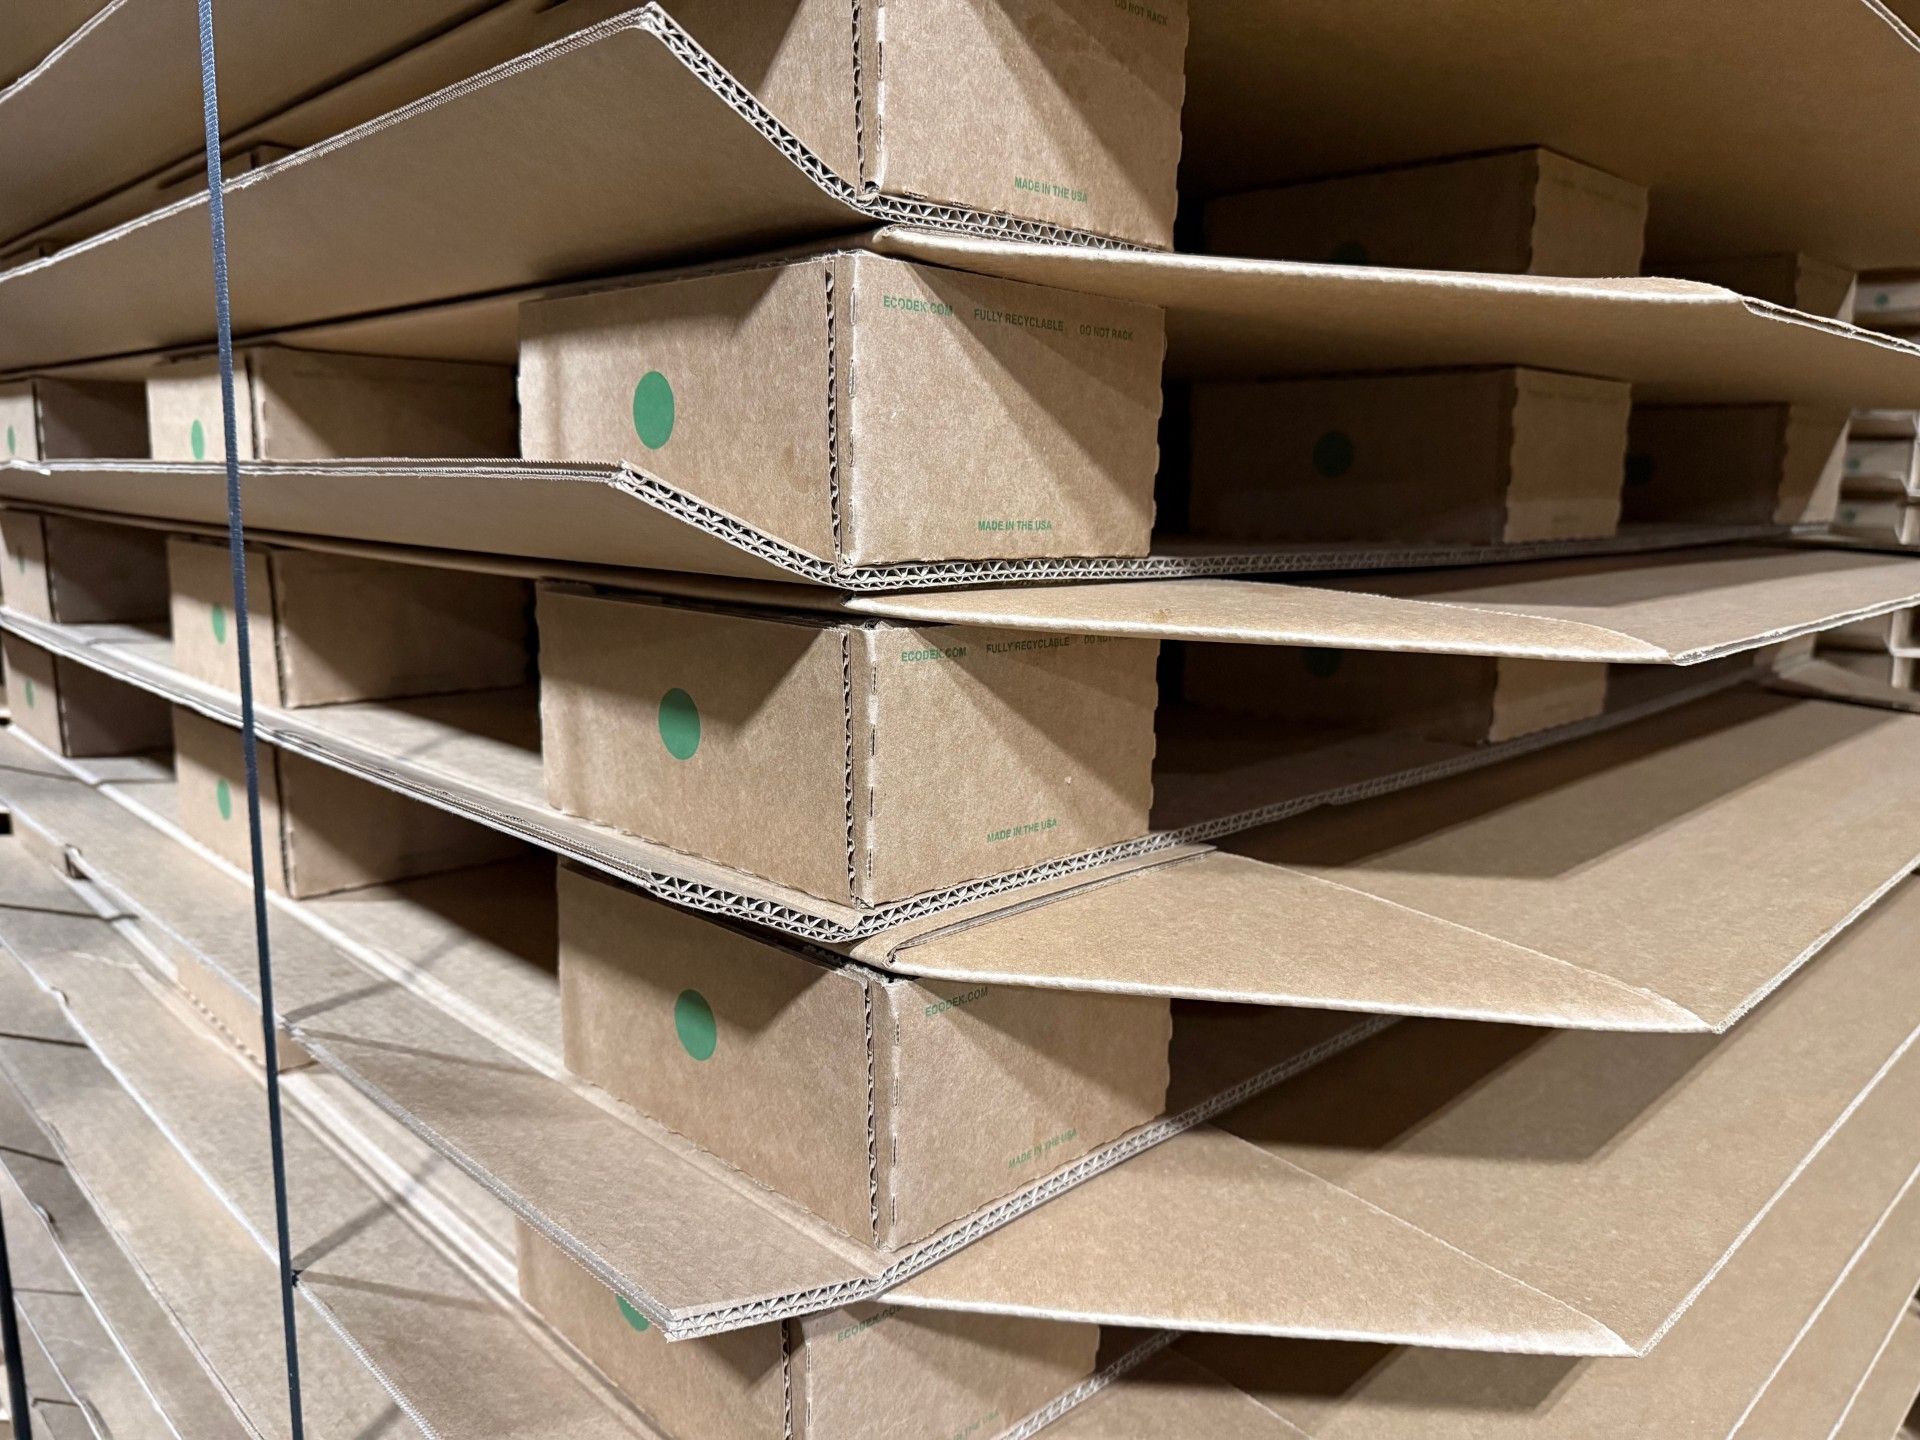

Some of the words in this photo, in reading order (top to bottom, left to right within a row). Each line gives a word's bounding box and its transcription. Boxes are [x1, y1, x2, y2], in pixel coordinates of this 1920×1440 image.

[1014, 175, 1041, 193] MADE
[1042, 182, 1051, 195] IN
[1052, 184, 1070, 199] THE
[1071, 189, 1088, 205] USA
[974, 308, 1004, 324] FULLY
[1004, 312, 1065, 332] RECYCLABLE
[1079, 324, 1092, 336] DO
[1094, 325, 1110, 338] NOT
[1112, 326, 1133, 341] RACK
[977, 520, 1004, 531] MADE
[1006, 519, 1015, 531] IN
[1016, 520, 1033, 531] THE
[1035, 519, 1052, 530] USA
[986, 641, 1014, 655] FULLY
[1014, 636, 1071, 652] RECYCLABLE
[987, 829, 1012, 844] MADE
[1012, 825, 1022, 837] IN
[1023, 822, 1041, 835] THE
[1040, 818, 1058, 831] USA
[925, 985, 988, 1018] ECODEK.COM
[1008, 1148, 1033, 1169] MADE
[1033, 1142, 1043, 1156] IN
[1043, 1135, 1061, 1152] THE
[1060, 1127, 1078, 1143] USA
